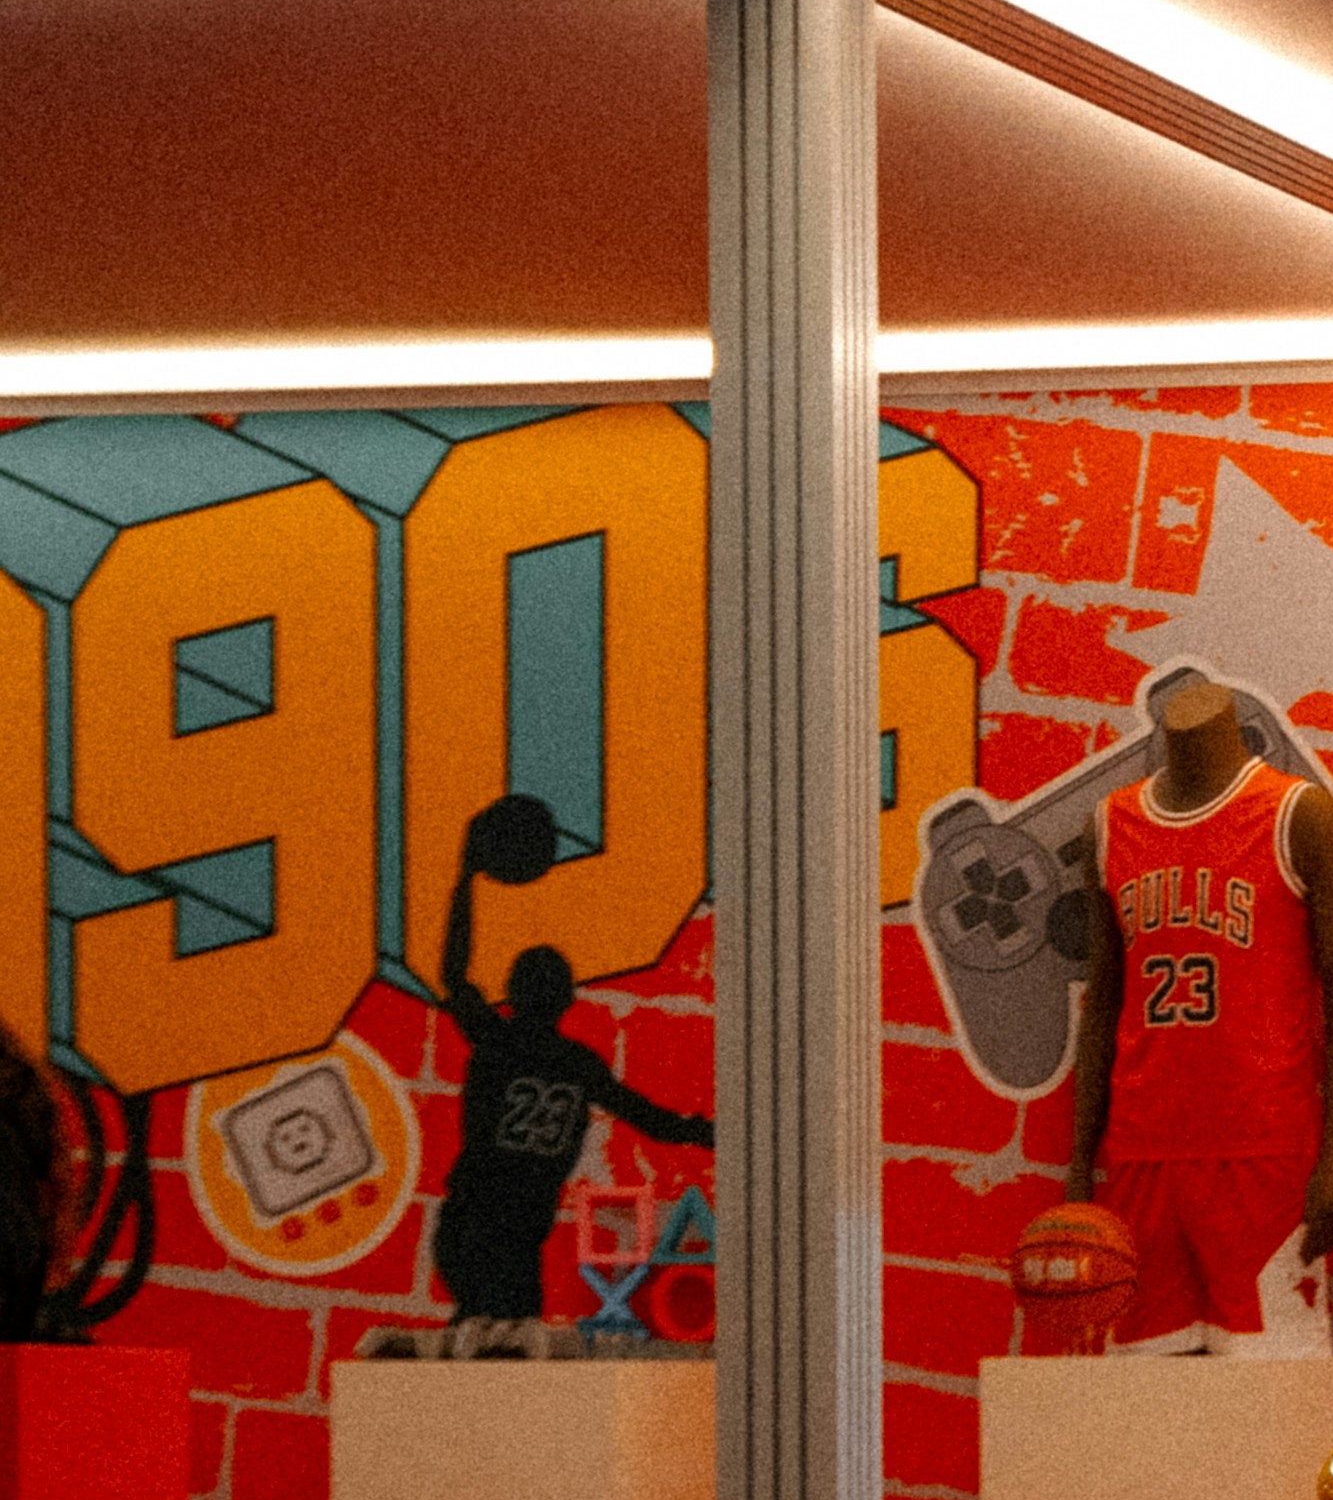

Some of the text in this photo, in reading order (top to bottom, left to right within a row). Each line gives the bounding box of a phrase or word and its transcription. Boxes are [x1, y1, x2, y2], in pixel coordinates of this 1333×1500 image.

[1118, 866, 1255, 951] BULLS
[1141, 953, 1220, 1029] 23
[497, 1077, 582, 1156] 23
